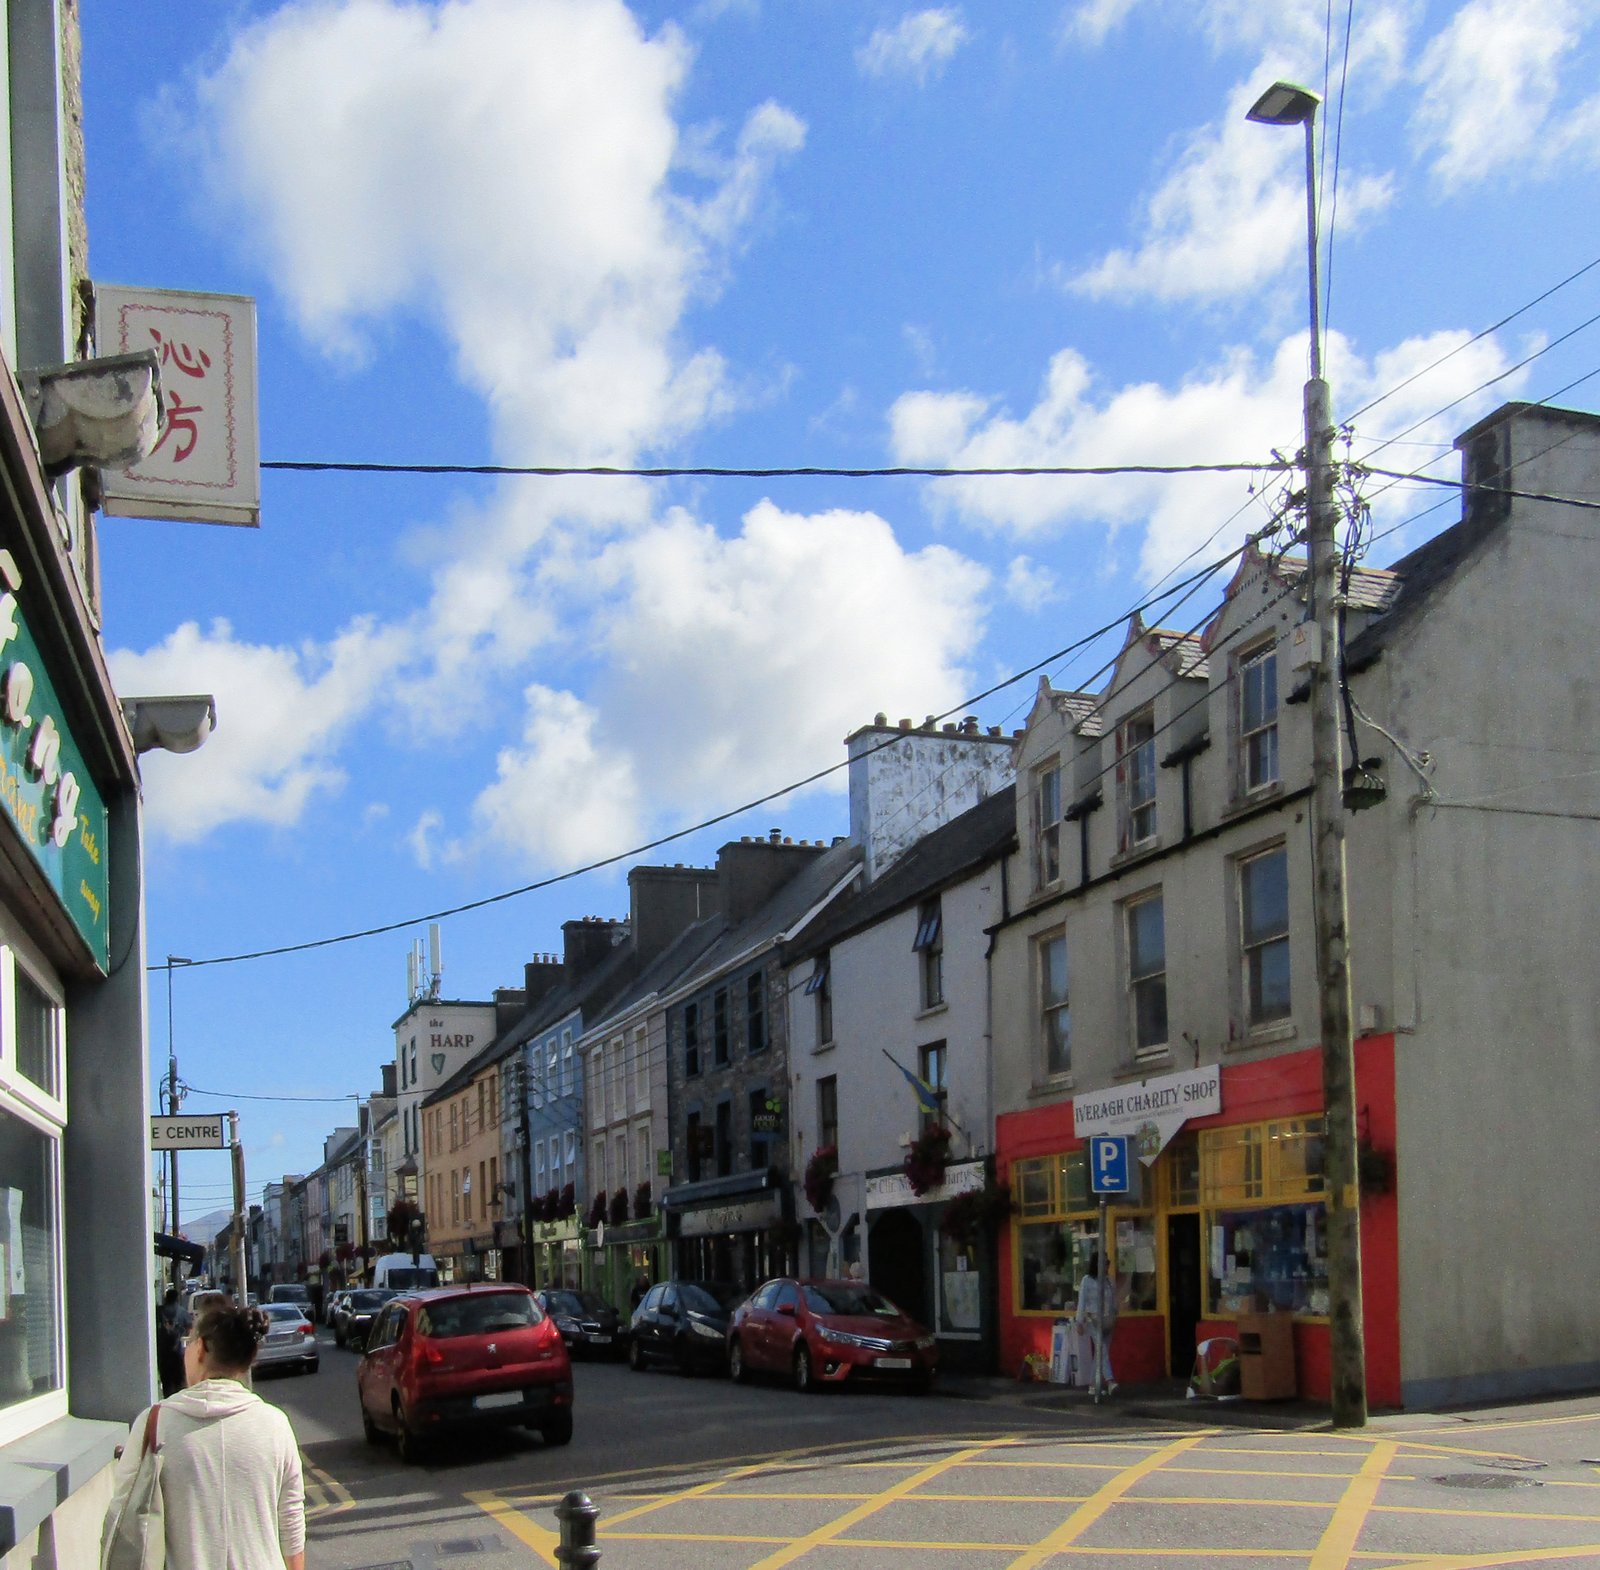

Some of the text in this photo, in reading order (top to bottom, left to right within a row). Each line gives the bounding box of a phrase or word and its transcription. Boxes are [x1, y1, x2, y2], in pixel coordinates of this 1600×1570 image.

[429, 1018, 444, 1028] the
[430, 1034, 474, 1048] HARP
[1075, 1097, 1124, 1123] IVERAGH
[1126, 1084, 1181, 1114] CHARITY
[1183, 1079, 1217, 1103] SHOP
[166, 1125, 220, 1139] CENTRE
[1099, 1141, 1119, 1172] P
